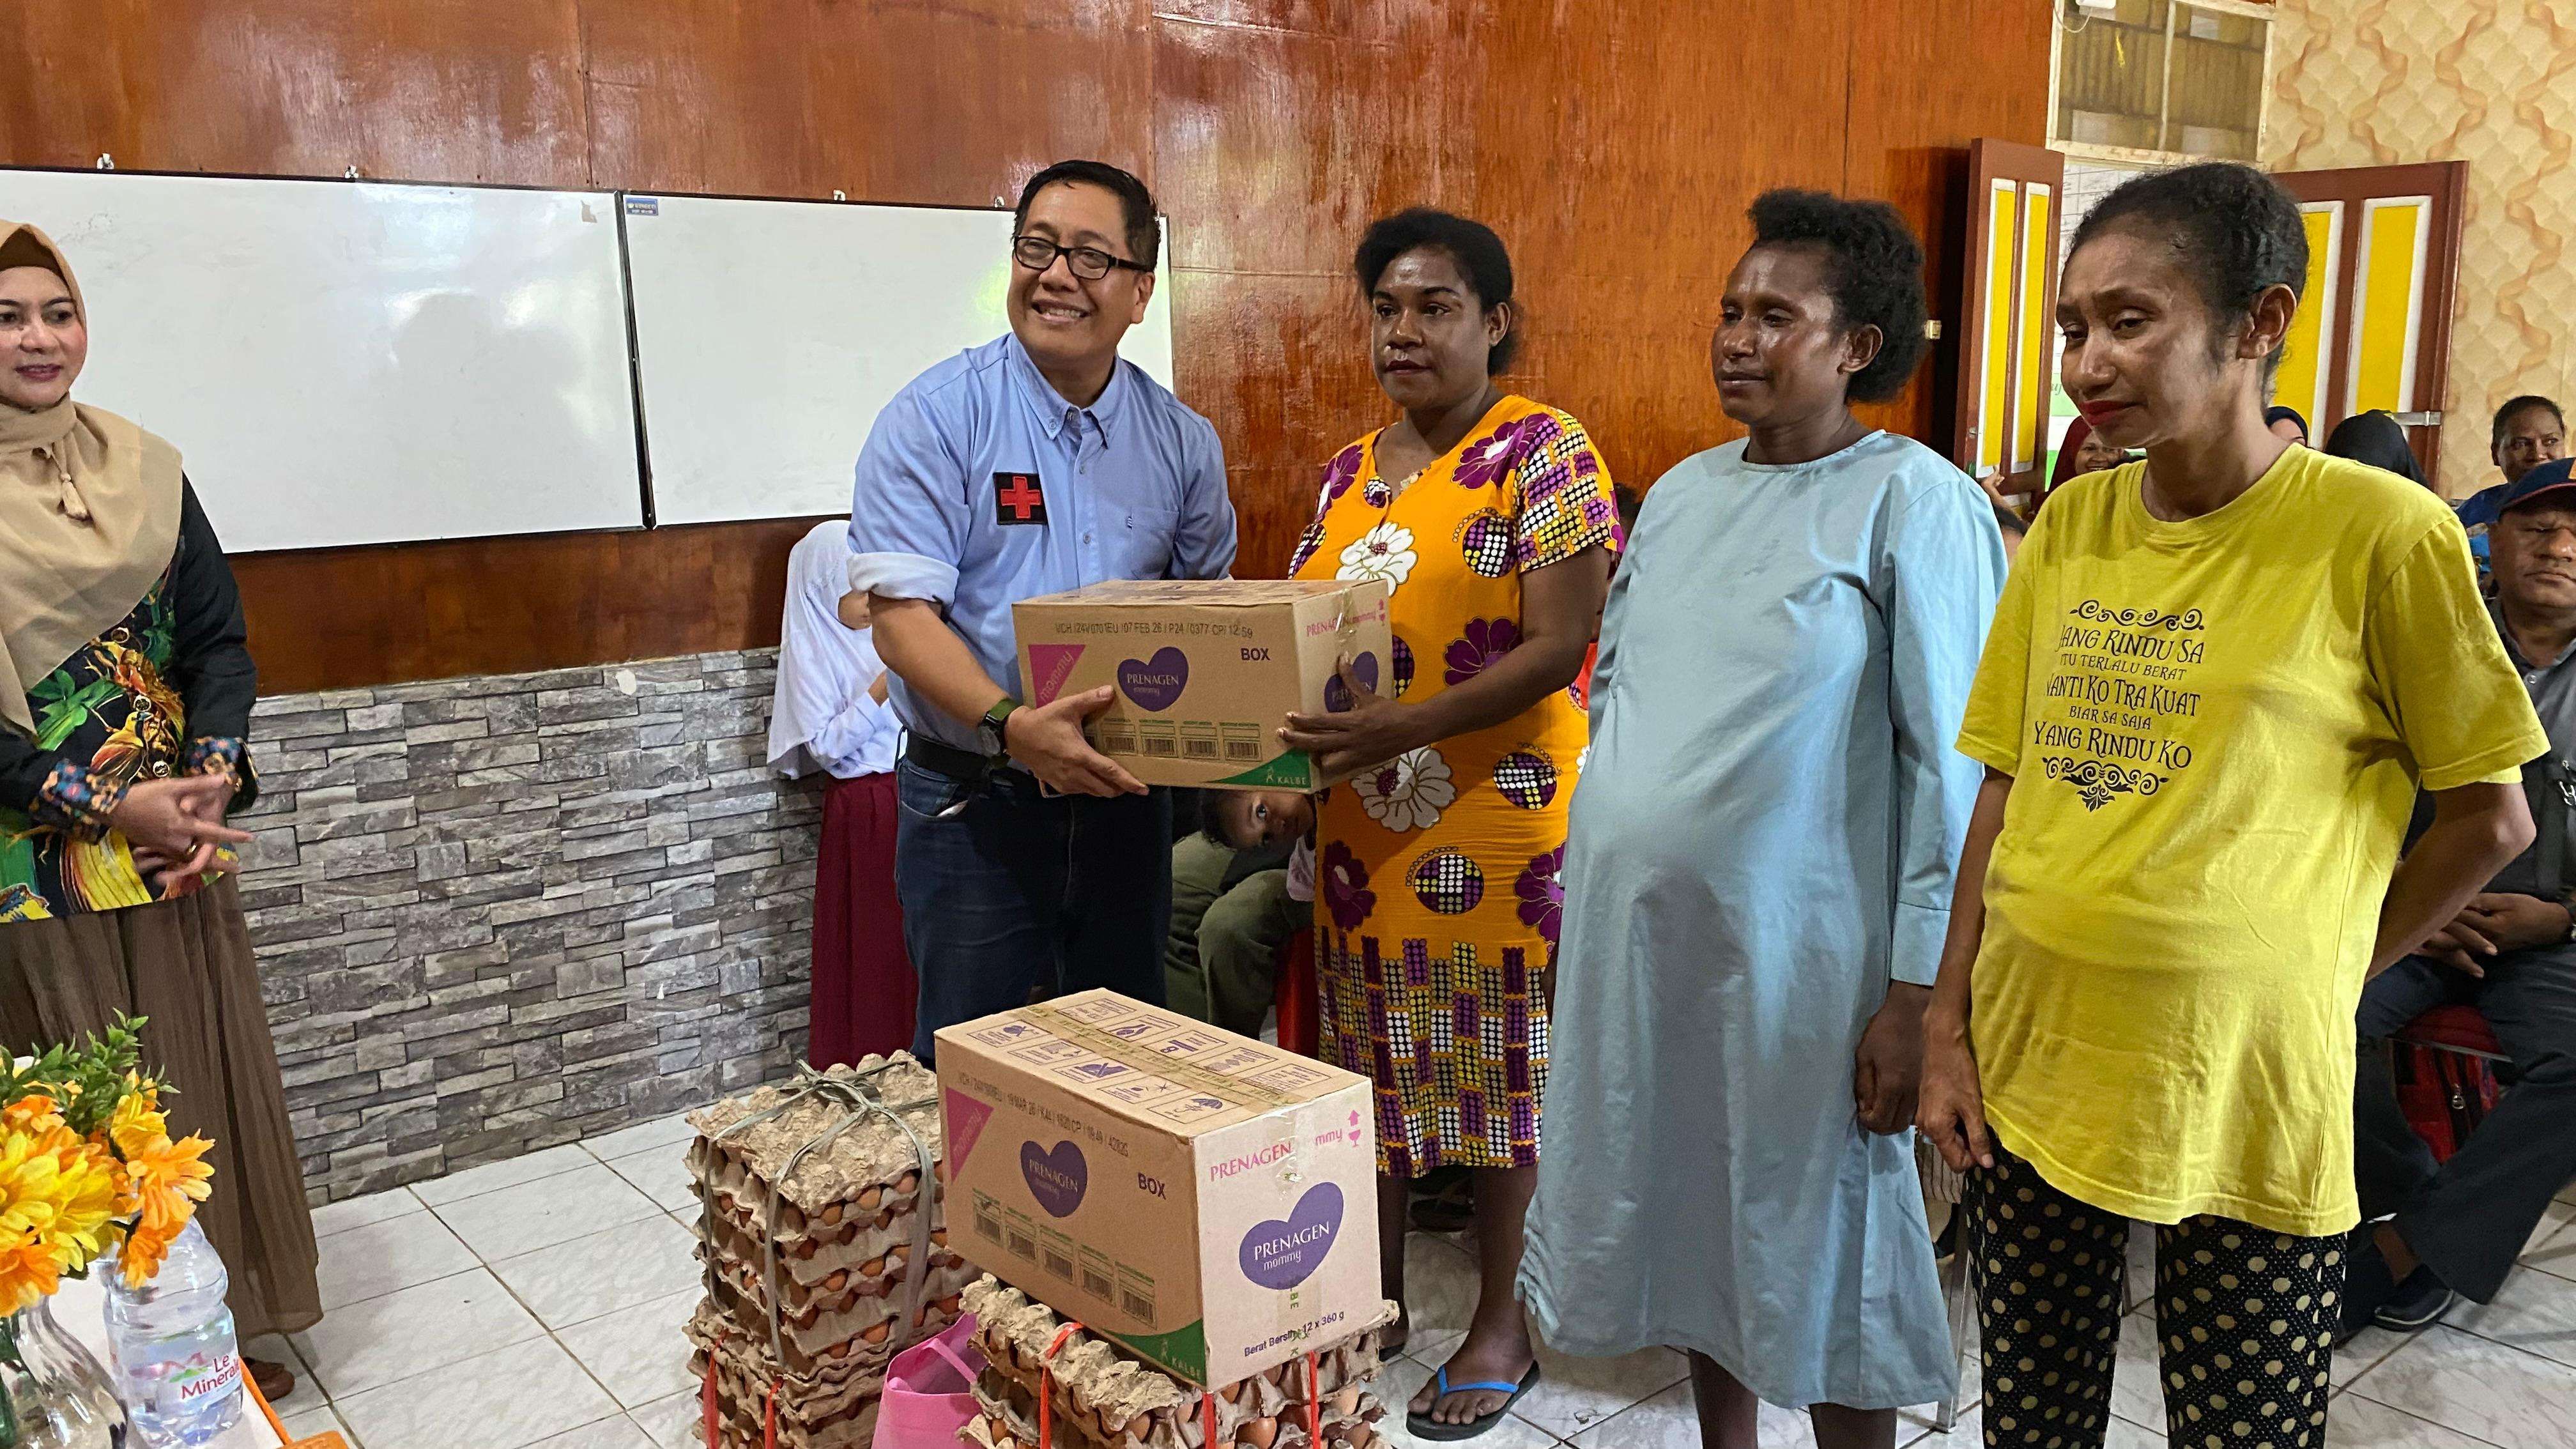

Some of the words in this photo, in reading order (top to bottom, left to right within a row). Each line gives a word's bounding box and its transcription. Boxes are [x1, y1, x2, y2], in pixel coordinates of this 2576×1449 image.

[1241, 647, 1270, 661] BOX
[2102, 629, 2174, 662] RINDU
[2177, 639, 2204, 664] SA
[1126, 672, 1179, 686] PRENAGEN
[2080, 654, 2140, 675] TERLALU
[2142, 664, 2187, 681] BERAT
[2086, 674, 2110, 705] KO
[2114, 678, 2147, 710] TRA
[2149, 684, 2200, 717] KUAT
[2068, 705, 2099, 723] BIAR
[2101, 710, 2117, 724] SA
[2121, 713, 2152, 730] SAJA
[2034, 721, 2082, 749] YANG
[2087, 727, 2156, 762] RINDU
[2158, 739, 2193, 770] KO
[1209, 1141, 1292, 1182] PRENAGEN
[1315, 1128, 1343, 1146] mmy
[1029, 1159, 1078, 1193] PRENAGEN
[1138, 1170, 1166, 1200] BOX
[1254, 1221, 1330, 1261] PRENAGEN
[1263, 1250, 1301, 1271] mommy
[1244, 1340, 1268, 1358] Berat
[1302, 1322, 1313, 1333] 12
[1314, 1321, 1321, 1330] x
[1321, 1312, 1337, 1326] 360
[1339, 1311, 1345, 1321] g
[213, 1354, 230, 1374] Le
